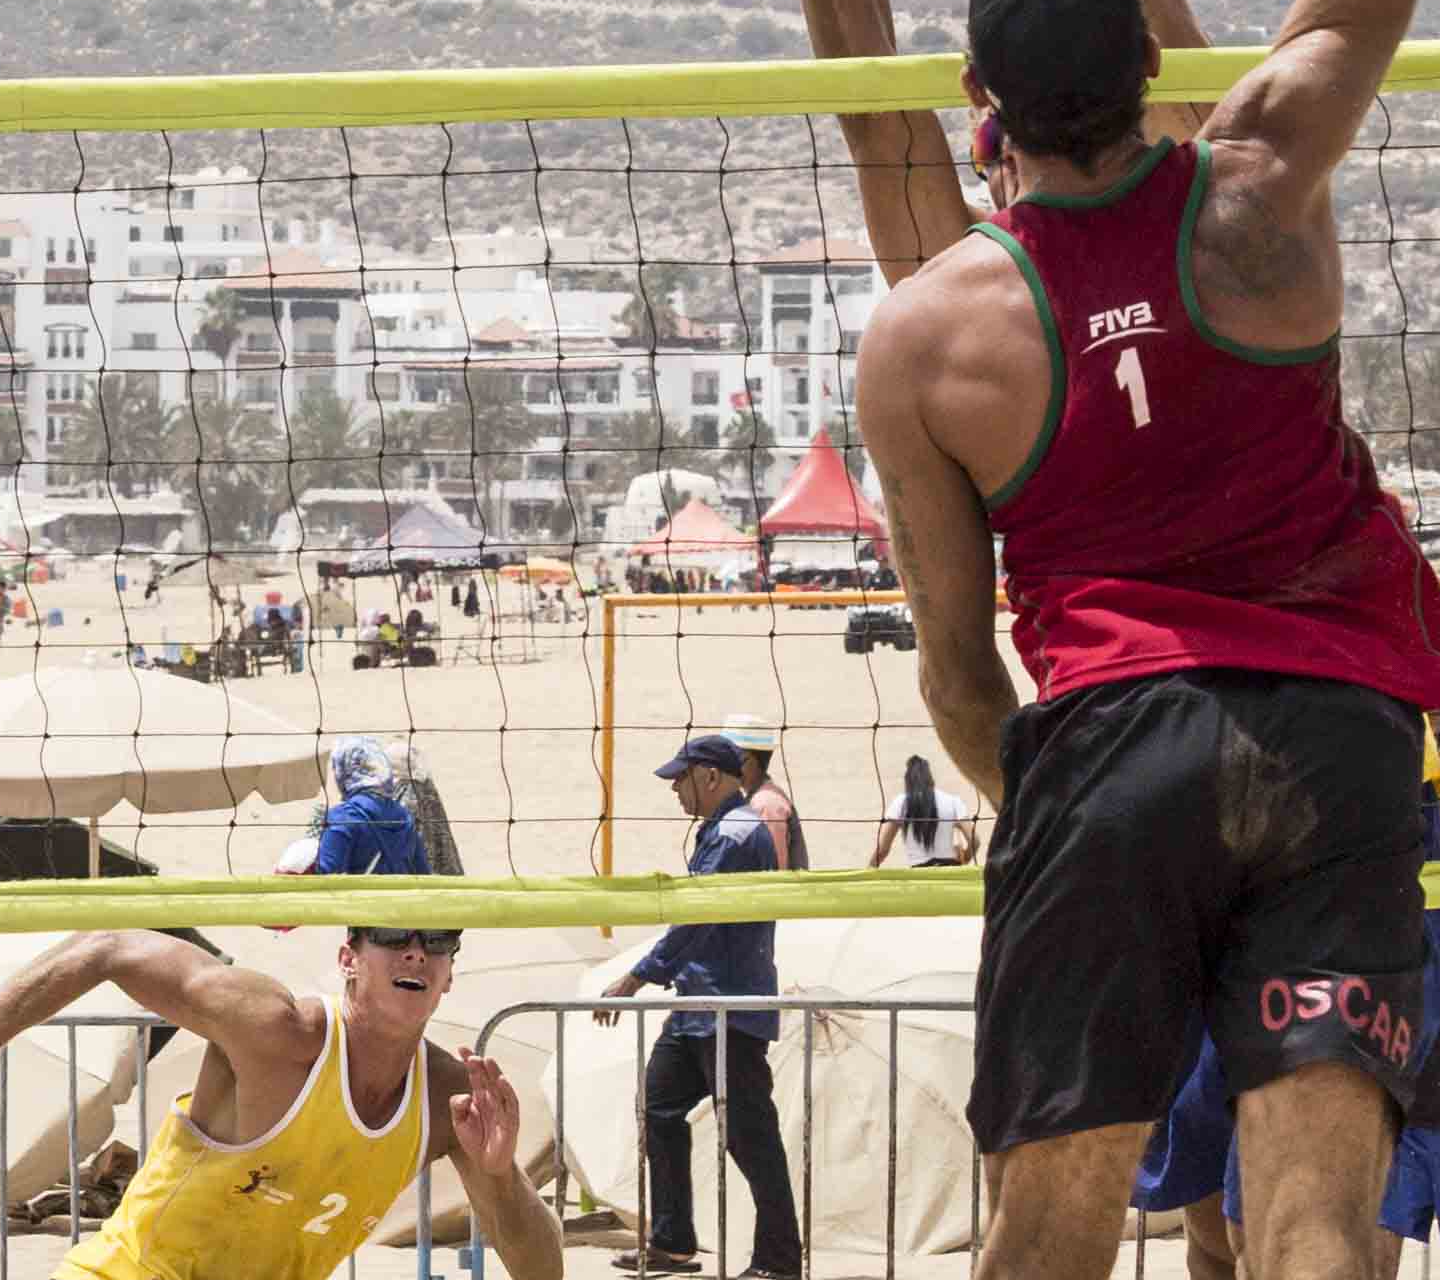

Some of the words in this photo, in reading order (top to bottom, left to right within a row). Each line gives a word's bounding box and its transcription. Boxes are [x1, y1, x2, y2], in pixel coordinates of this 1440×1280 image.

[1088, 301, 1154, 338] FIVB
[1115, 347, 1151, 429] 1
[1260, 977, 1411, 1070] OSCAR
[303, 1192, 348, 1234] 2
